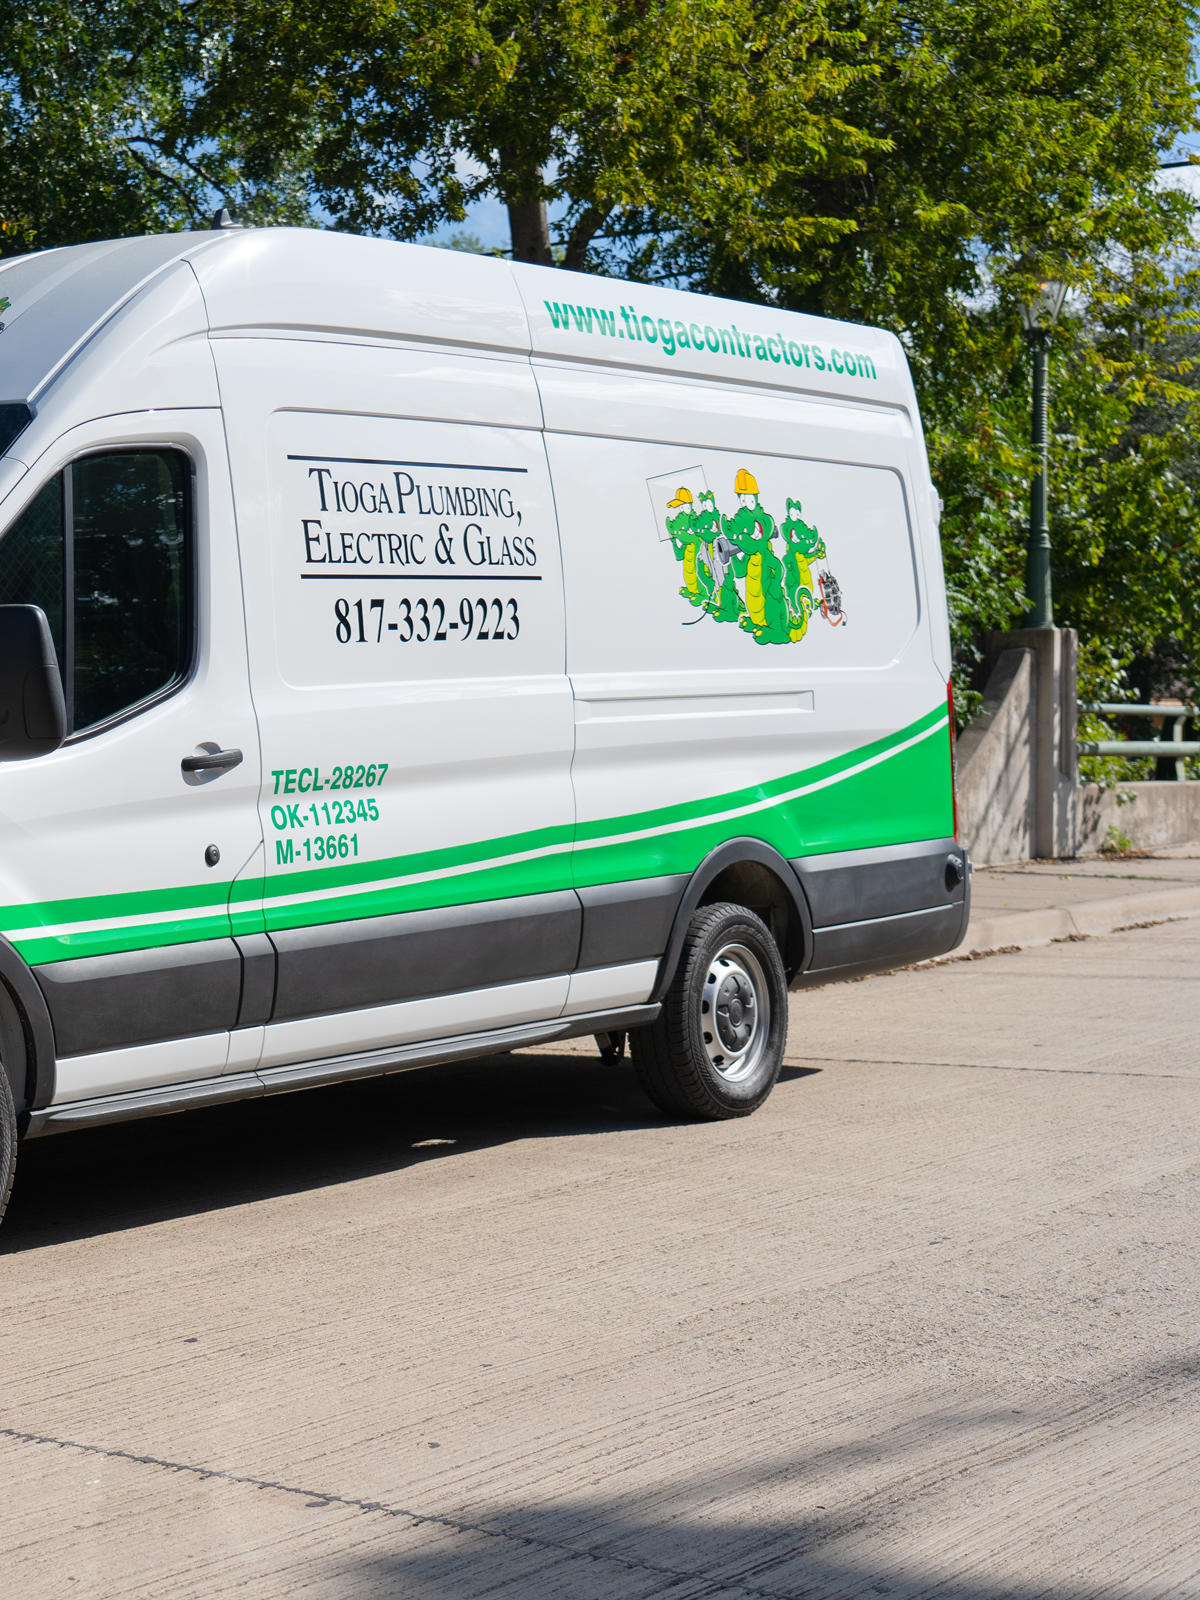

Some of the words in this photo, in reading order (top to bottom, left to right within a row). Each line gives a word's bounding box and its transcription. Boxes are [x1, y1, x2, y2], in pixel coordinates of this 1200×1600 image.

[543, 300, 878, 380] www.tiogacontractors.com
[434, 522, 456, 566] &
[334, 597, 520, 644] 817-332-9223
[271, 763, 389, 795] TECL-28267
[270, 798, 380, 830] OK-112345
[275, 833, 359, 865] M-13661
